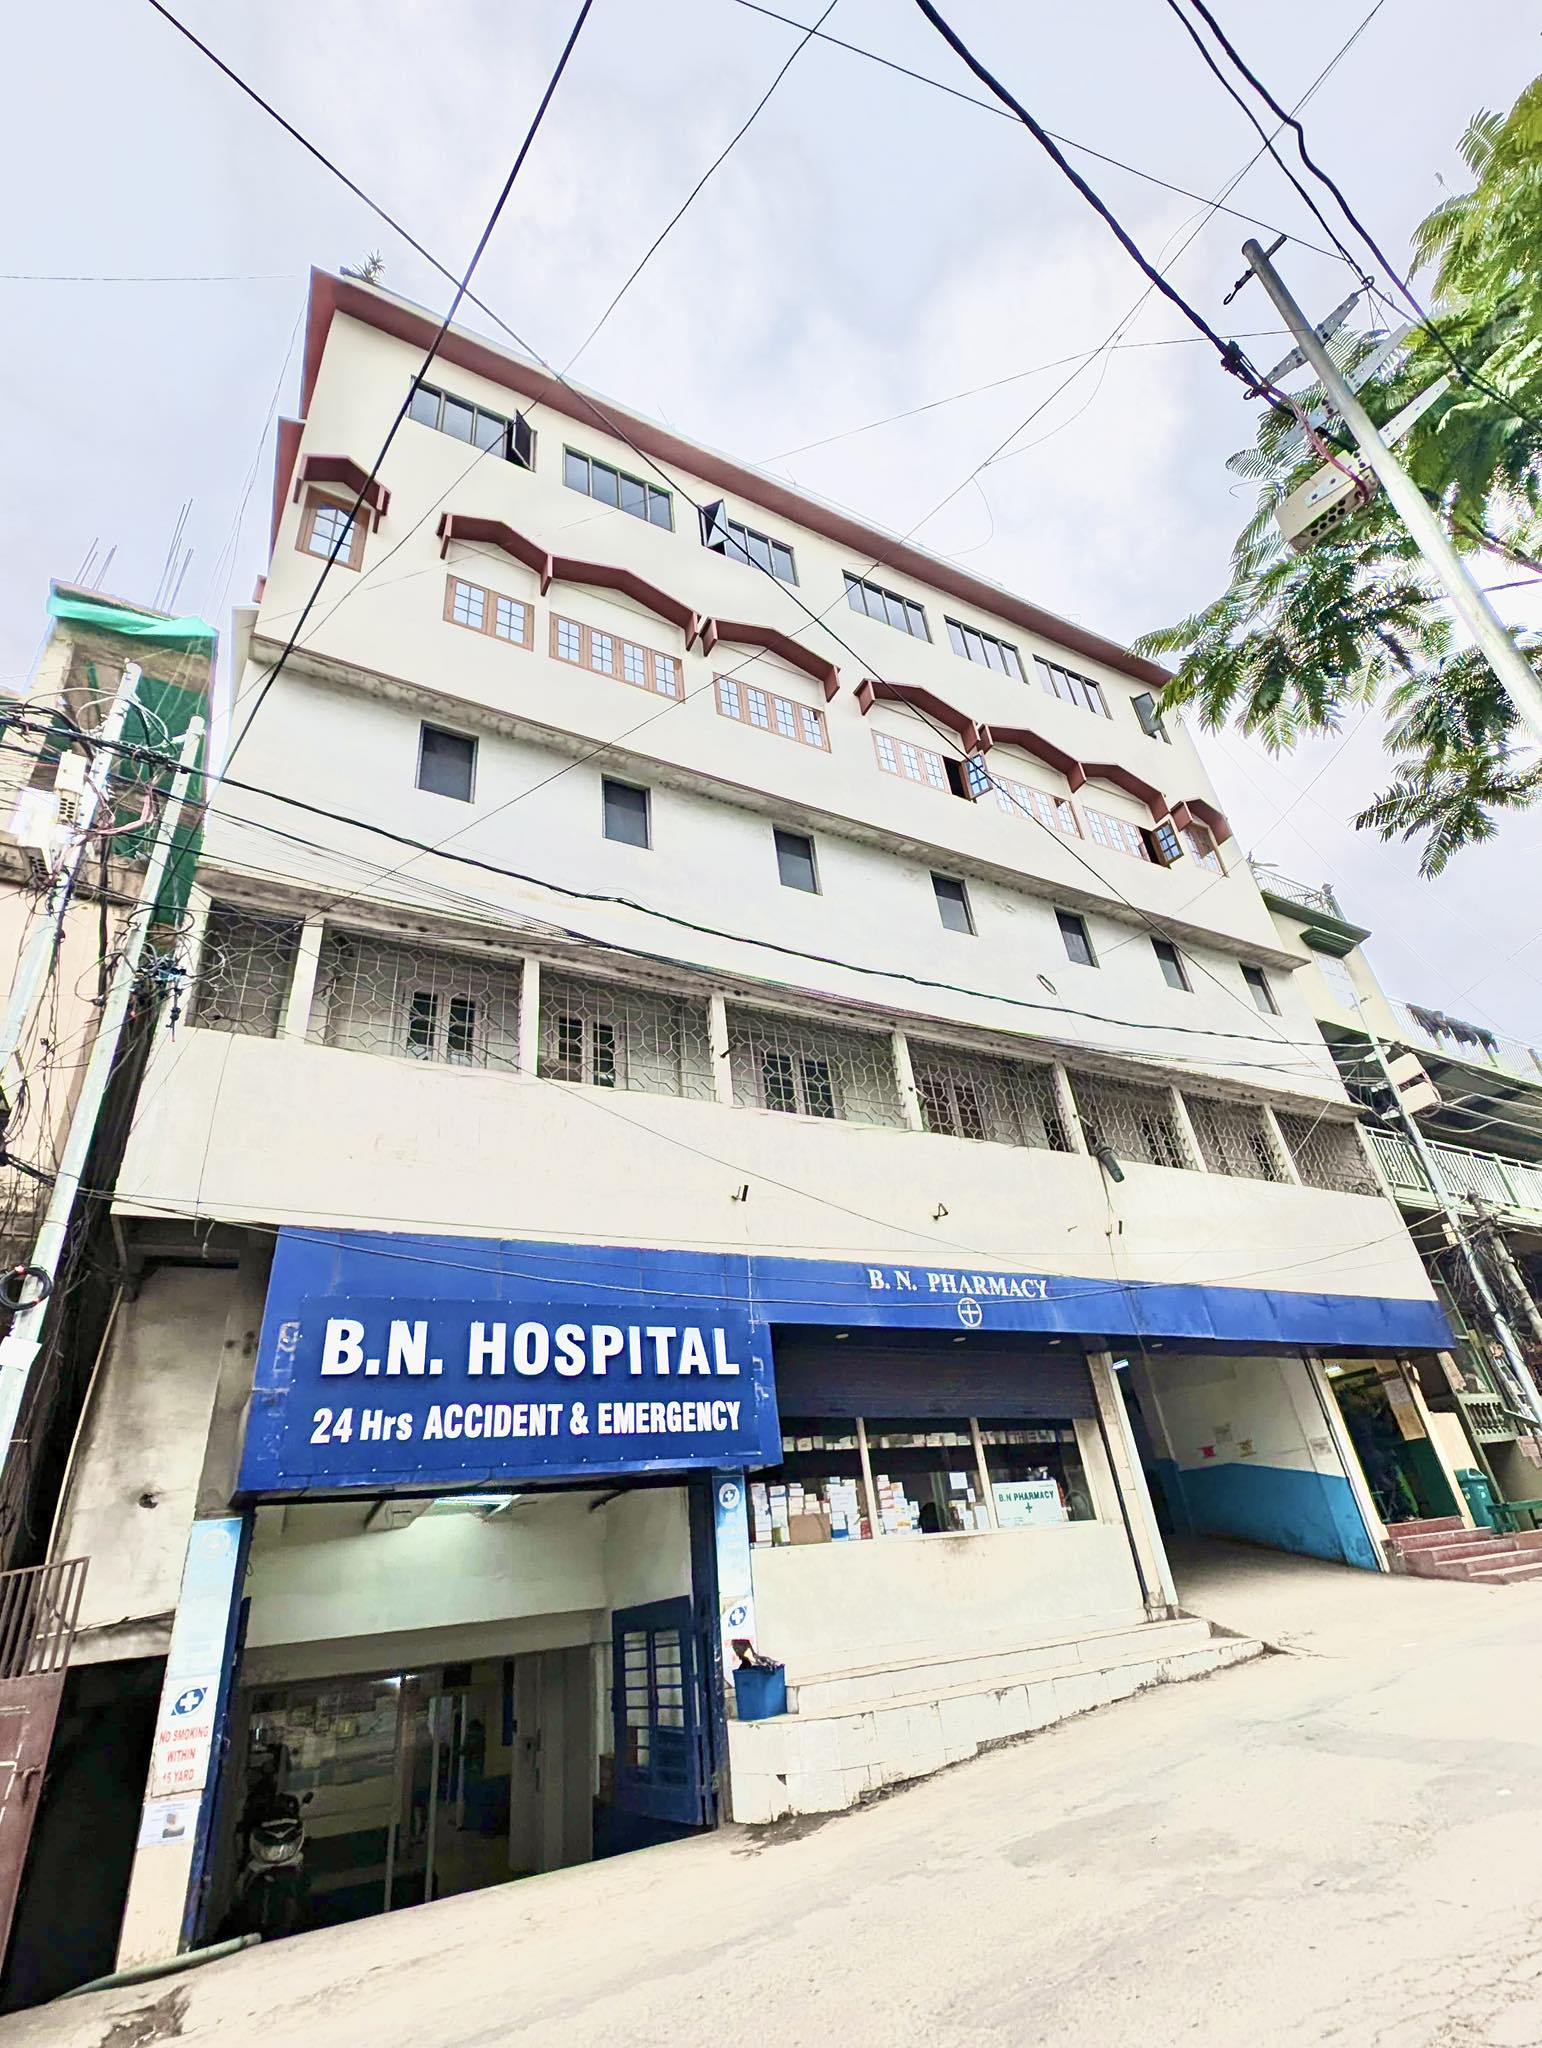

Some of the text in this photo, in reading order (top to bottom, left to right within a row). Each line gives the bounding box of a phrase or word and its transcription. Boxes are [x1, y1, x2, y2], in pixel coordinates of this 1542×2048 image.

[927, 1272, 1047, 1298] PHARMACY
[321, 1318, 740, 1376] B.N. HOSPITAL
[310, 1400, 741, 1444] 24 Hrs ACCIDENT & EMERGENCY
[1013, 1490, 1054, 1501] PHARMACY
[160, 1726, 208, 1743] NO SMOKING
[167, 1748, 195, 1762] WITHIN
[174, 1769, 194, 1782] YARD
